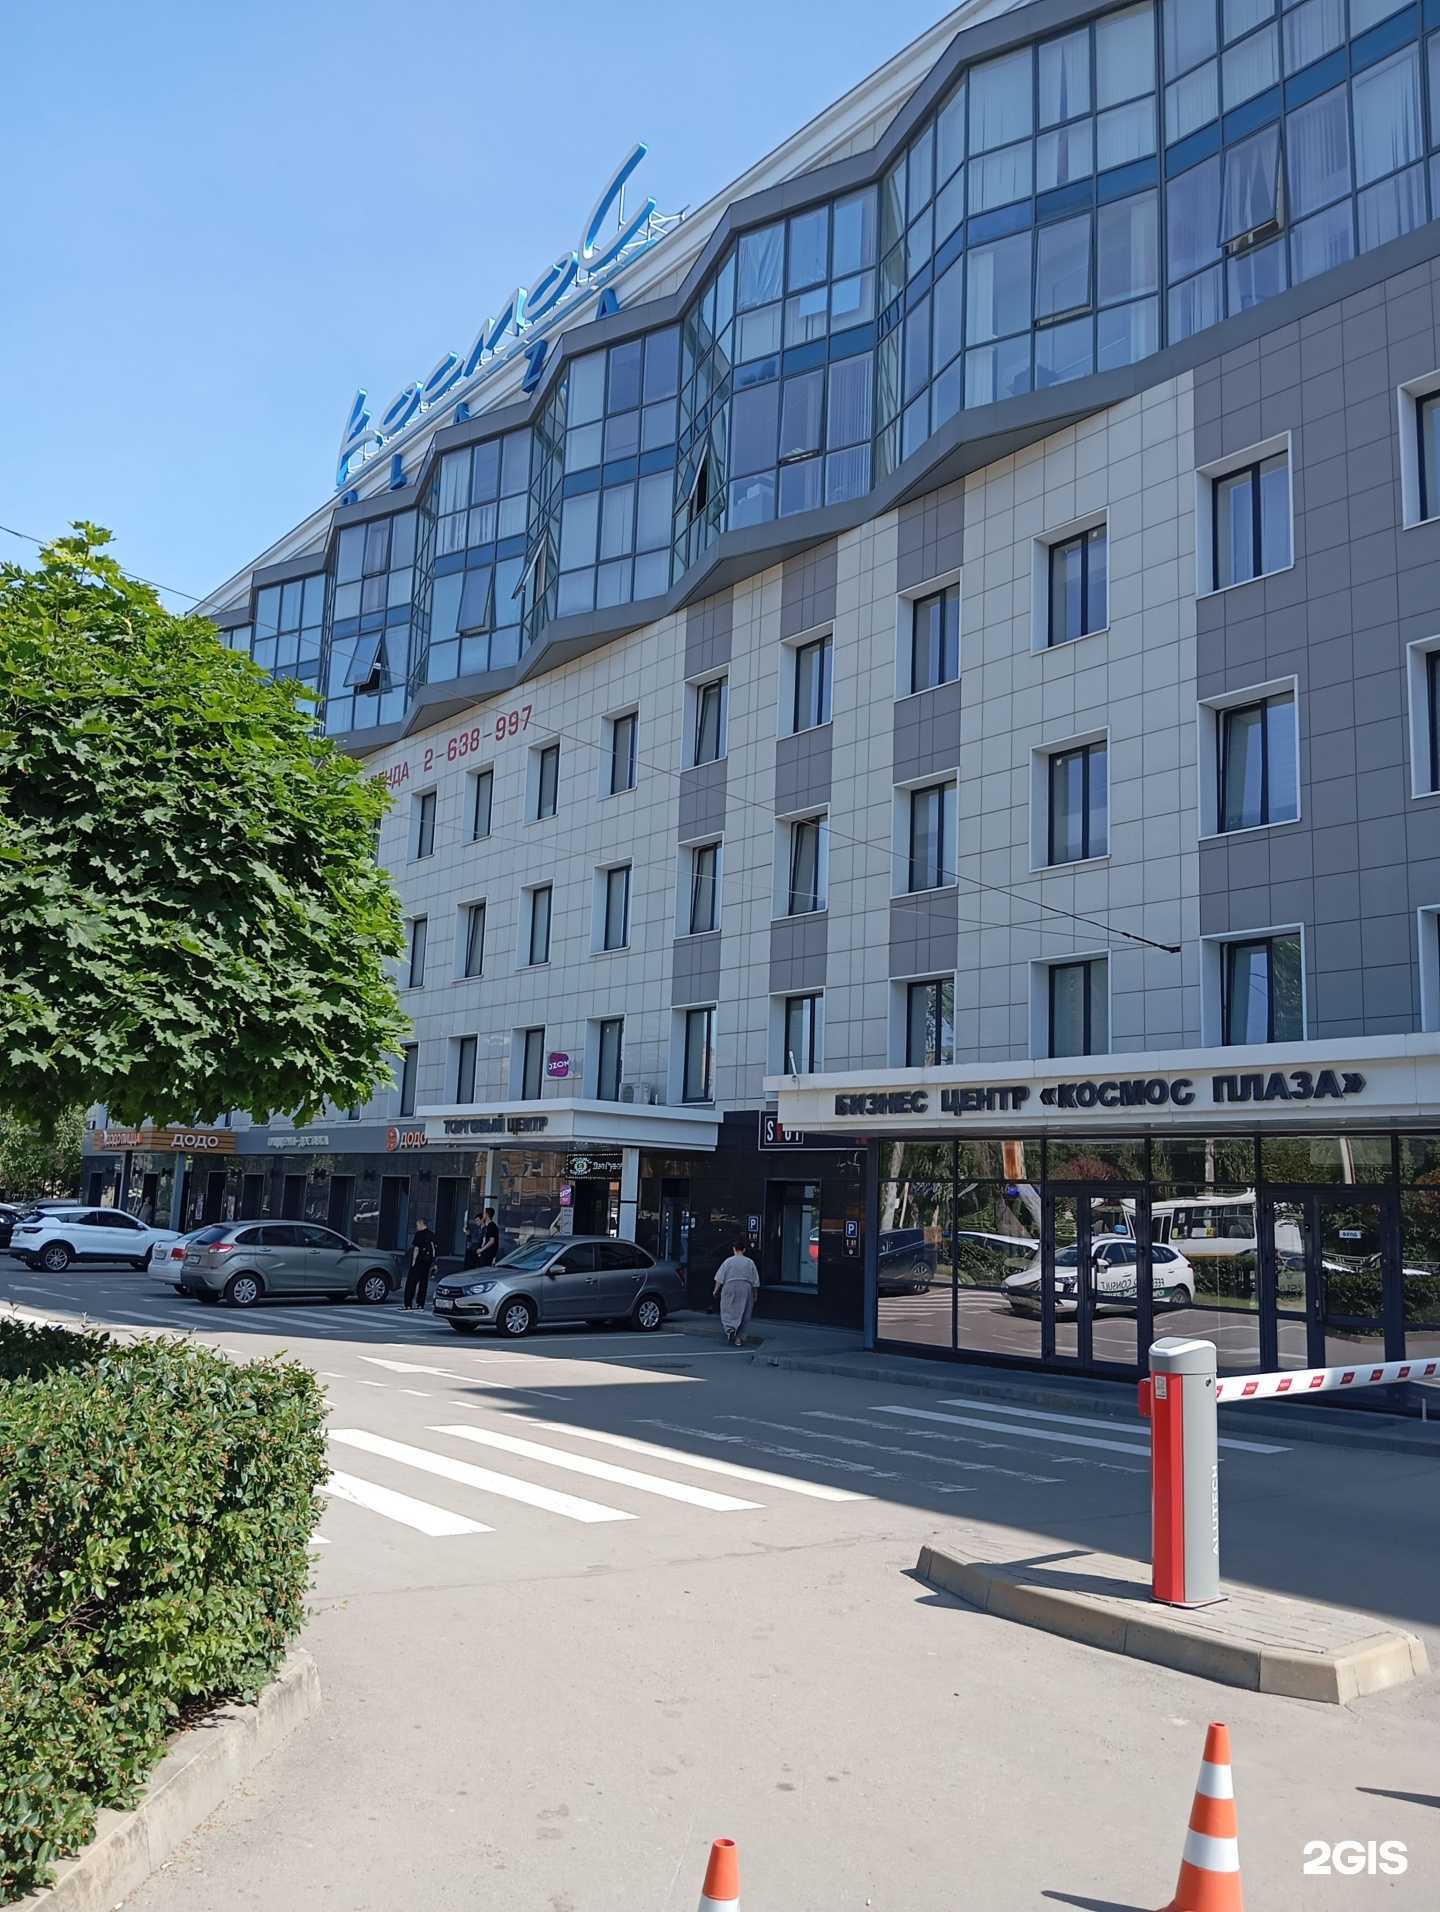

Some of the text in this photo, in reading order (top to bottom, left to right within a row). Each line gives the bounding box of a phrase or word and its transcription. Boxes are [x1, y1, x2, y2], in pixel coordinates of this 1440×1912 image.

[423, 703, 533, 773] 2-638-997
[834, 1069, 1367, 1116] БИЗНЕС ЦЕНТР «КОСМОС ПЛАЗА»
[443, 1115, 549, 1136] ТОРГОВЫЙ ЦЕНТР
[170, 1133, 219, 1149] ДОДО
[848, 1223, 855, 1235] P
